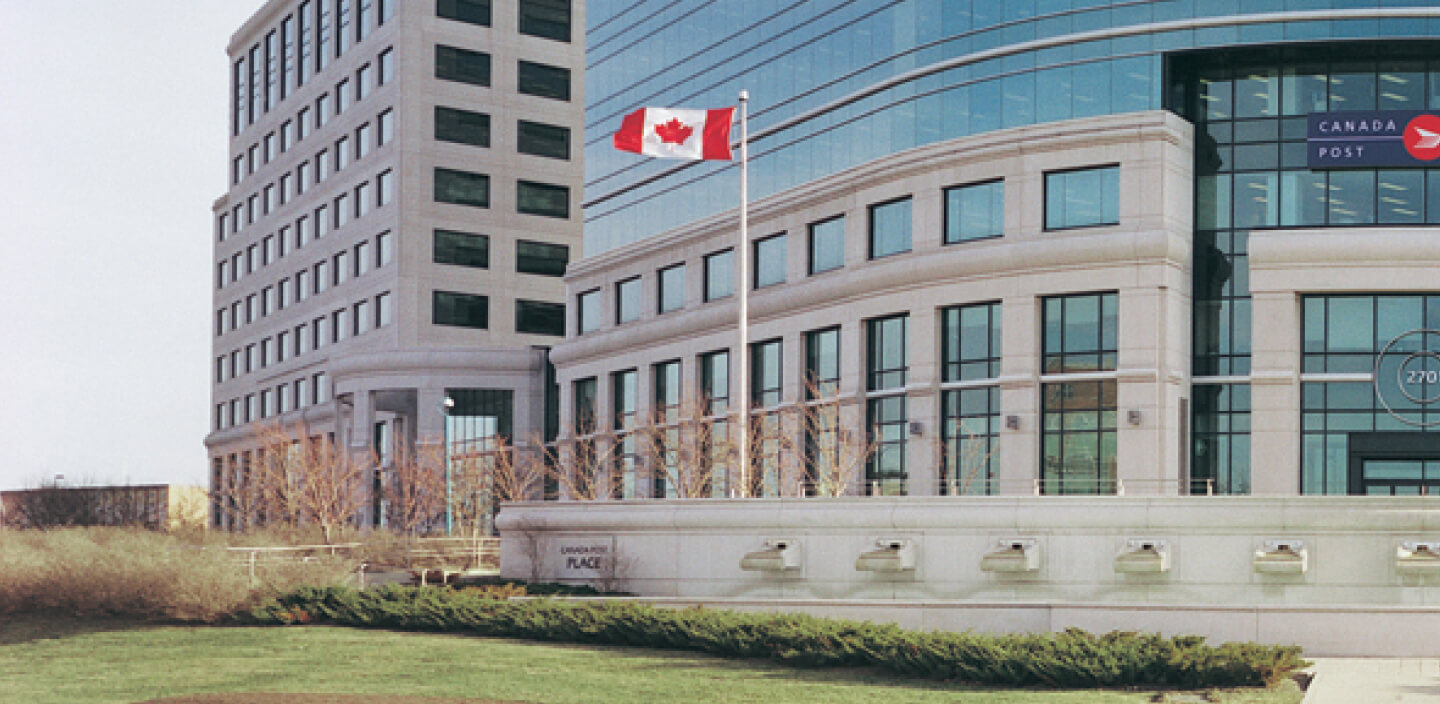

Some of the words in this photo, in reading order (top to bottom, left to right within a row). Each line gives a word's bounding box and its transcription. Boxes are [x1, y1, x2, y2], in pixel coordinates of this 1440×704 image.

[1318, 119, 1397, 132] CANADA
[1318, 146, 1365, 158] POST
[566, 557, 600, 569] PLACE
